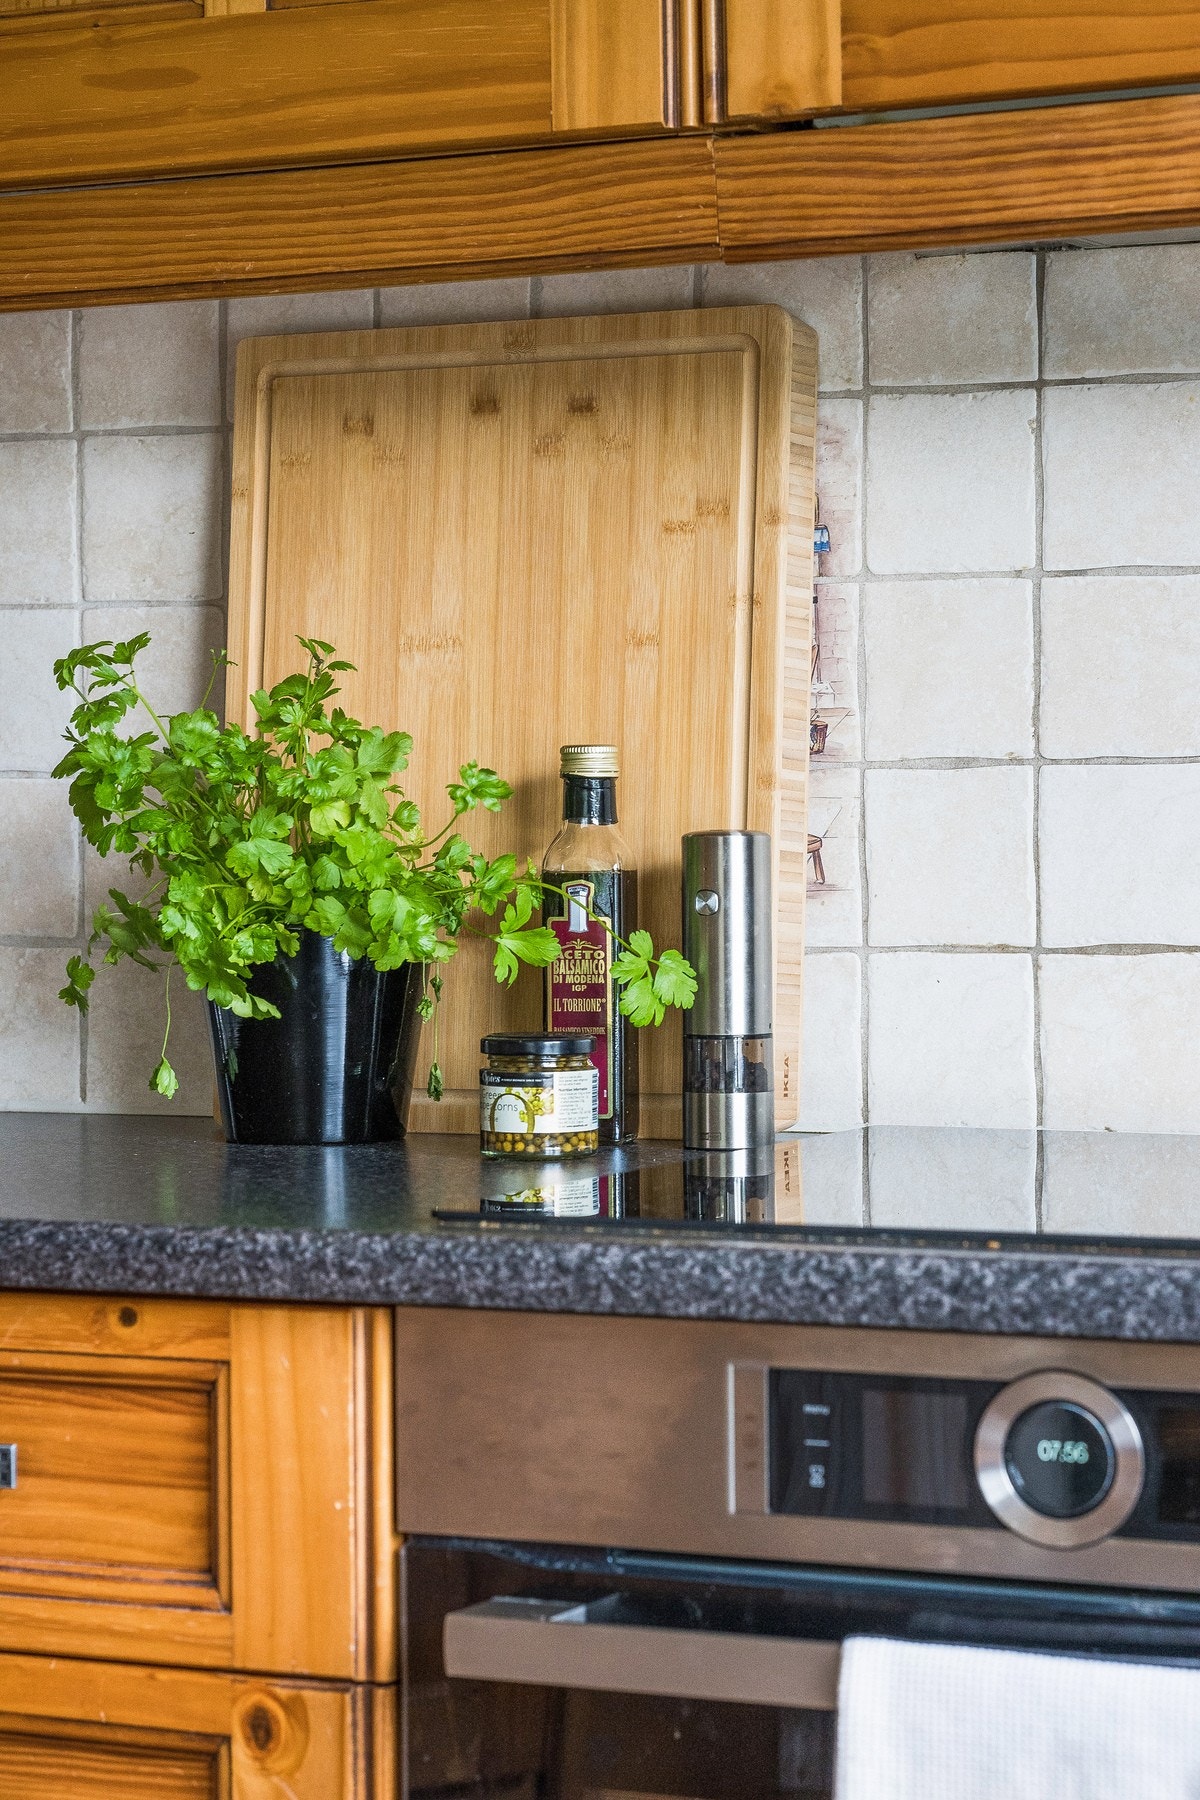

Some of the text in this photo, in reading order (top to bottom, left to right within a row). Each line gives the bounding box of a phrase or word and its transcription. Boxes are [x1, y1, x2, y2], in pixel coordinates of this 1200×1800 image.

[553, 959, 605, 975] BALSAMICO
[553, 974, 605, 984] DI MODENA
[571, 984, 587, 992] IGP
[553, 998, 562, 1012] IL
